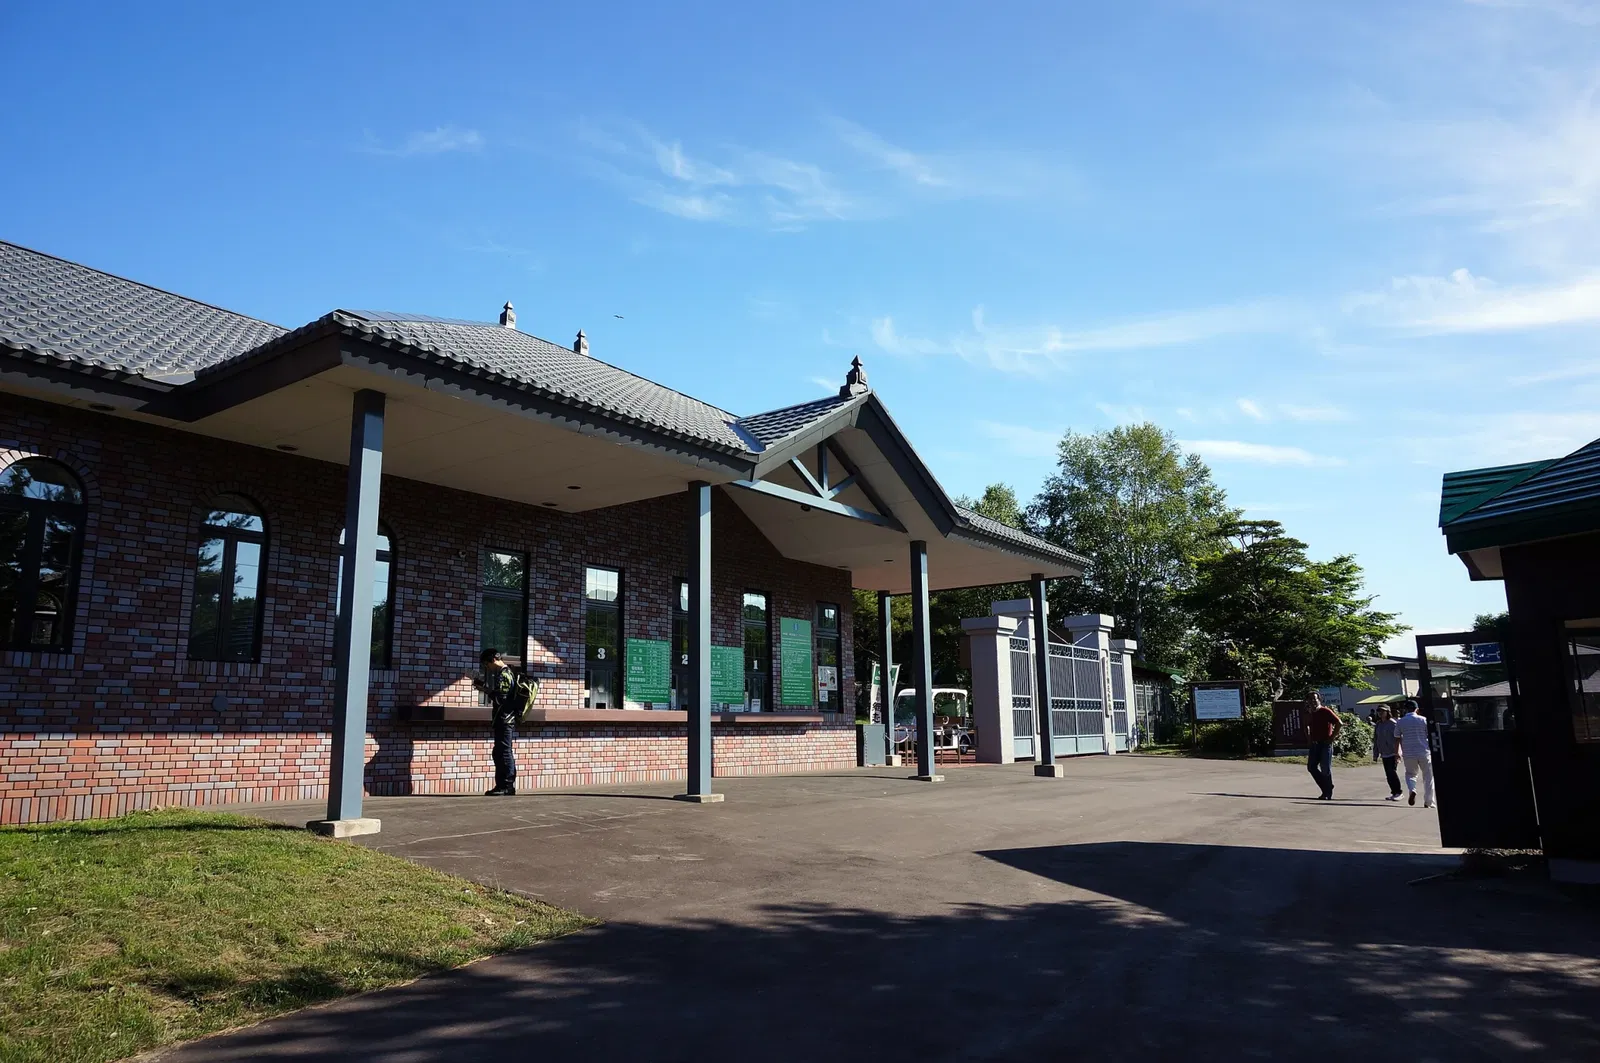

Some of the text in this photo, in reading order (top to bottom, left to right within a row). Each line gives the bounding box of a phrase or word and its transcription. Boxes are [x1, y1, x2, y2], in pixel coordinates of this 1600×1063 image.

[597, 647, 606, 660] 3
[681, 653, 688, 665] 2
[753, 659, 759, 670] 1
